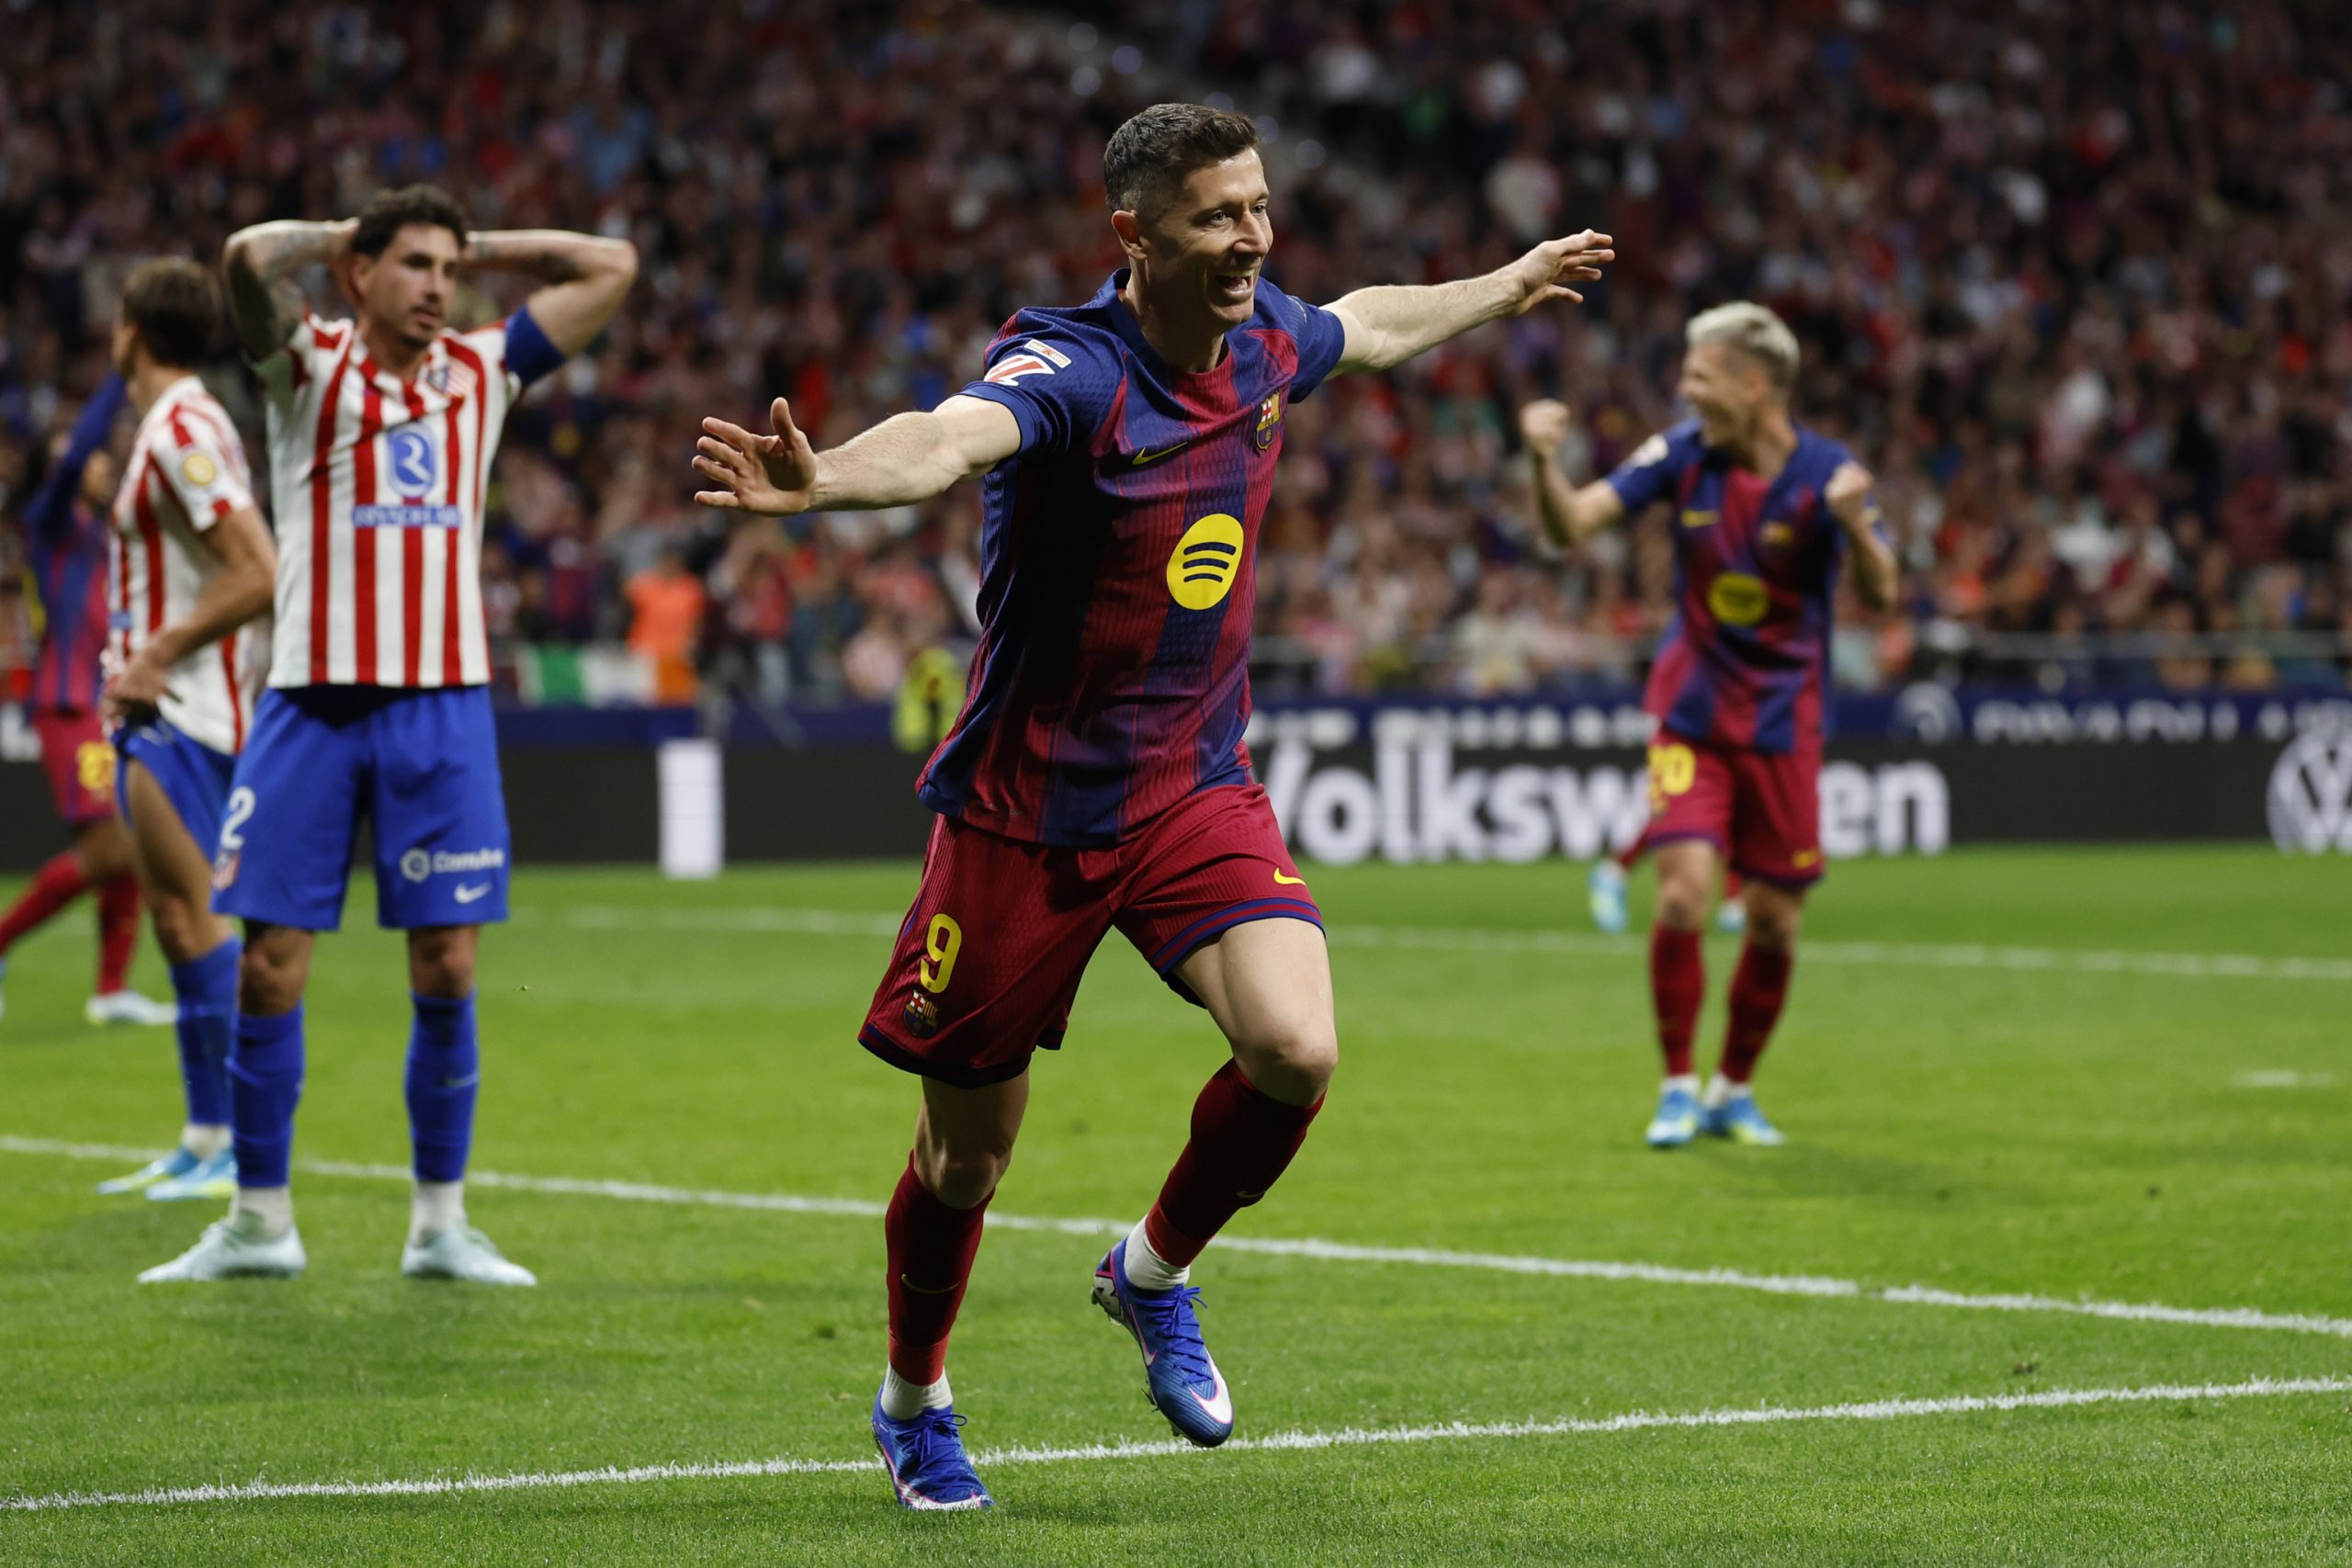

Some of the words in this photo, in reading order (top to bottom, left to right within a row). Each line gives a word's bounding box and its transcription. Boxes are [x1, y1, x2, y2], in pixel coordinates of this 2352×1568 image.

[220, 785, 256, 850] 2
[1257, 735, 1950, 865] olkswen
[921, 913, 962, 994] 9
